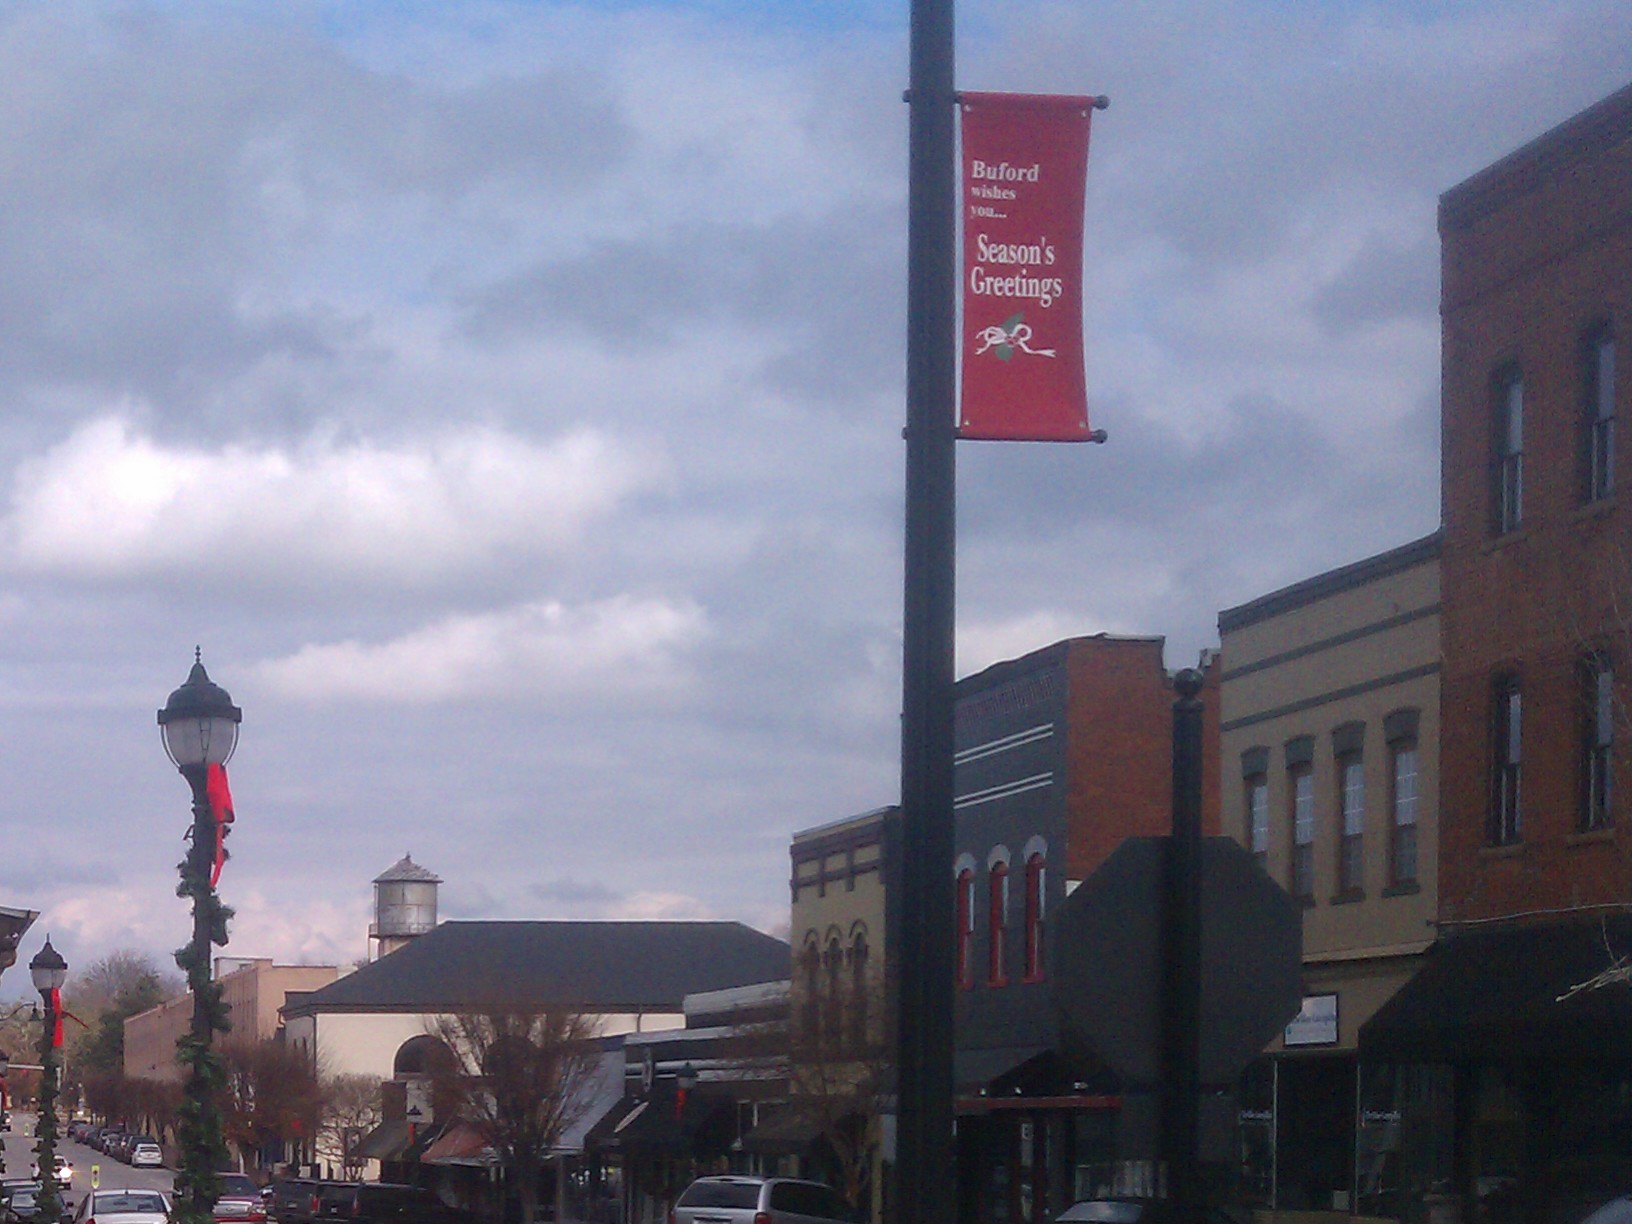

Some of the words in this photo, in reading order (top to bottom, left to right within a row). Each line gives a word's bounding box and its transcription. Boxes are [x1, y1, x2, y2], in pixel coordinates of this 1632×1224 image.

[971, 160, 1039, 182] Buford
[971, 185, 1017, 200] wishes
[970, 204, 1007, 219] you...
[976, 233, 1055, 265] Season's
[971, 266, 1063, 308] Greetings
